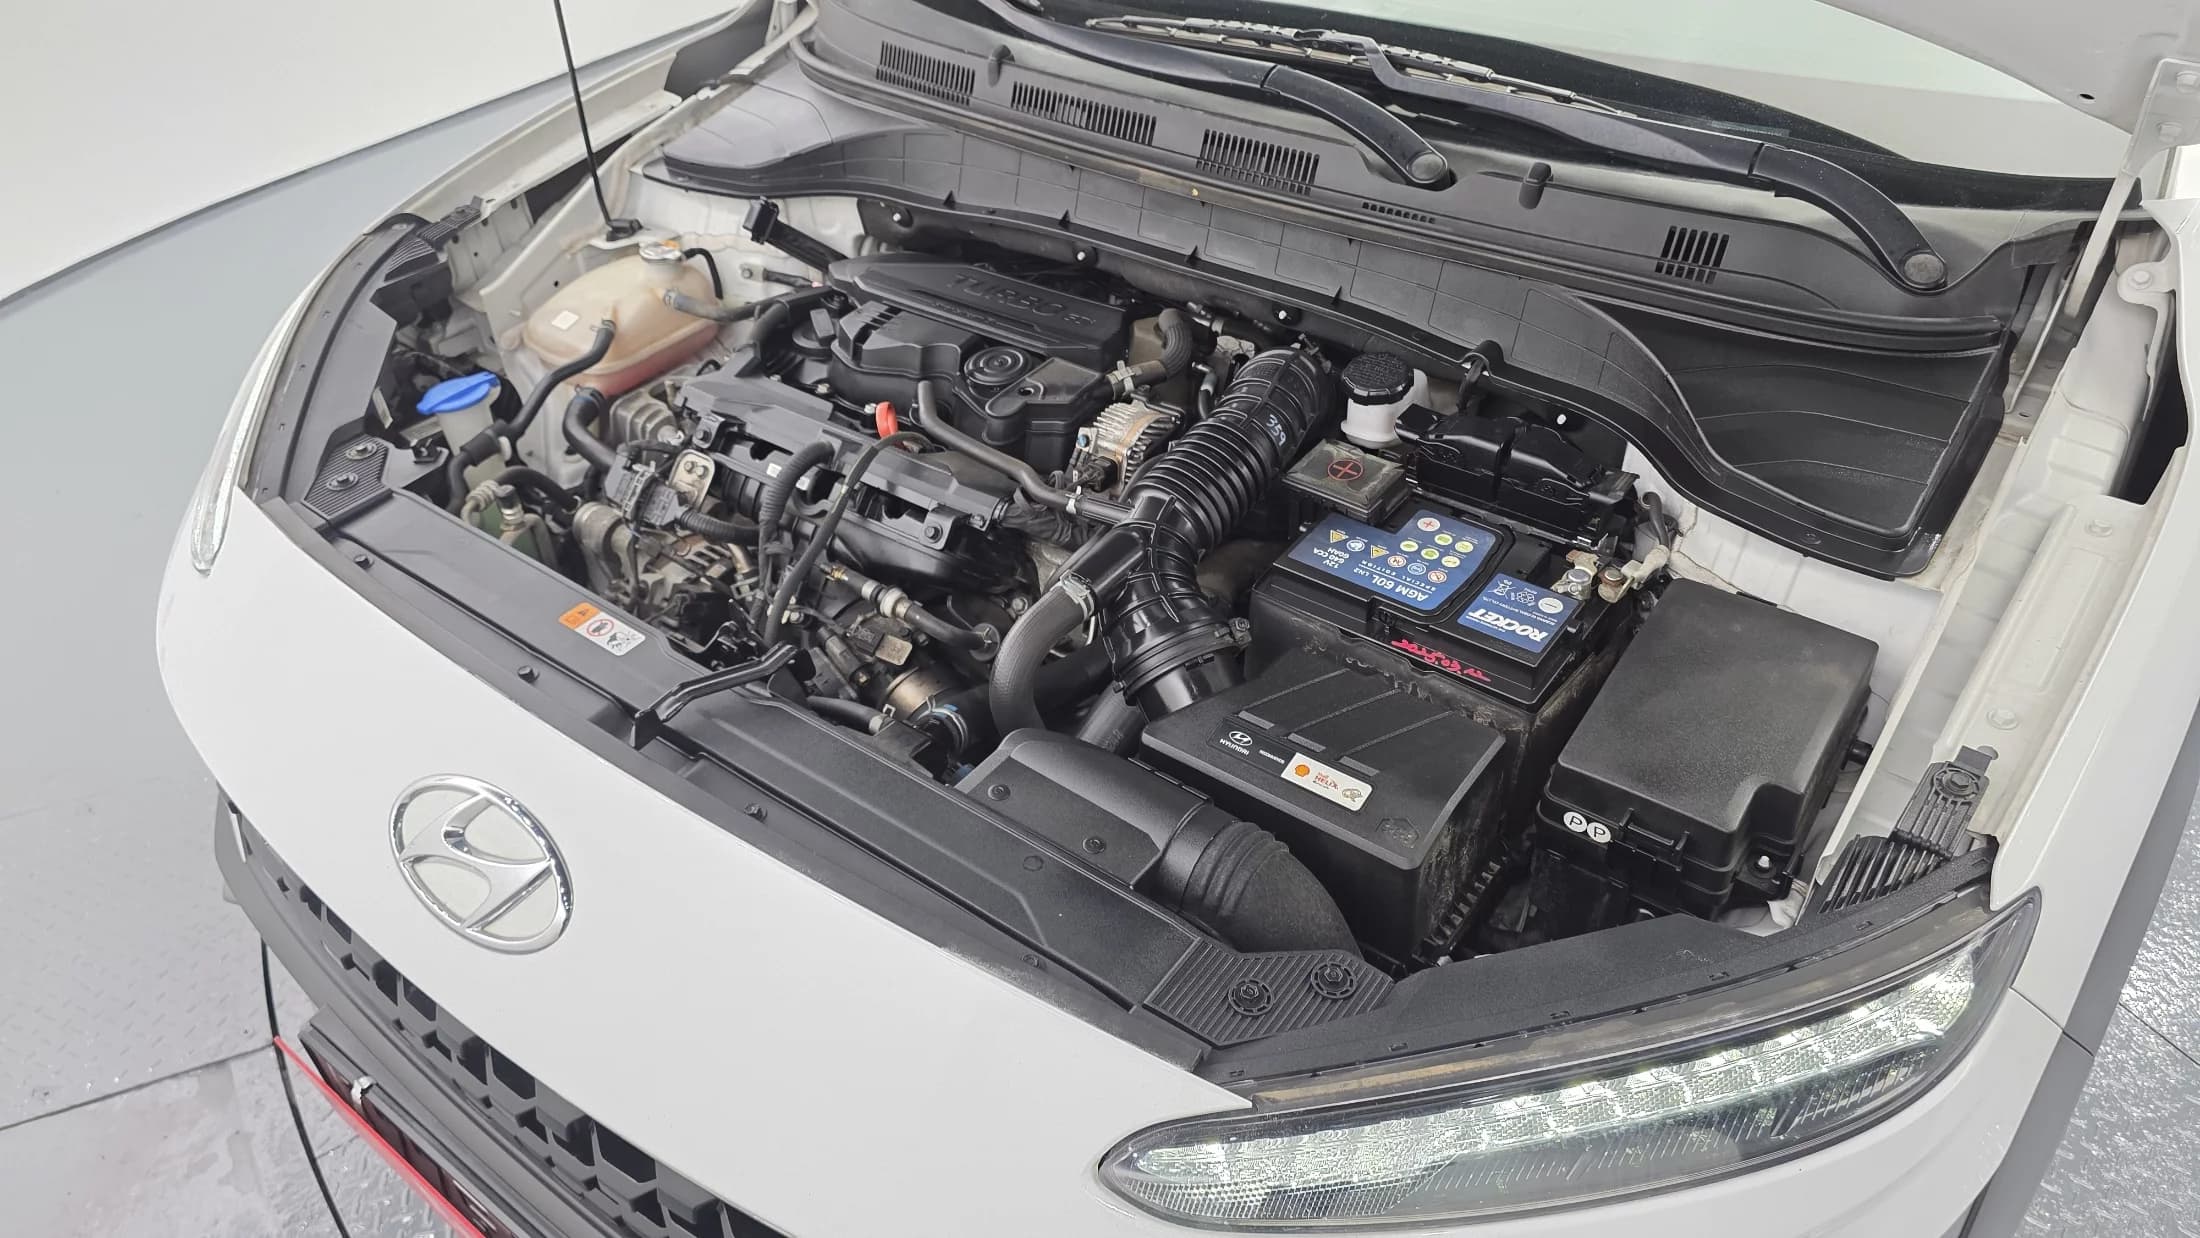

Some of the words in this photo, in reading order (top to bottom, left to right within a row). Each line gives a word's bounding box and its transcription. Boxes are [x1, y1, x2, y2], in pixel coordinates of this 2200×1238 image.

[948, 273, 1063, 316] TURBO
[1265, 414, 1287, 447] 359
[1313, 547, 1328, 558] CCA
[1323, 560, 1339, 569] 12V
[1361, 560, 1397, 576] EDITION
[1371, 574, 1396, 590] 60L
[1401, 575, 1436, 592] SPECIAL
[1395, 586, 1431, 602] AGM
[1467, 608, 1549, 642] ROCKET
[1219, 738, 1250, 756] HYUNDAI
[1315, 775, 1337, 790] HELIX
[1569, 815, 1583, 826] P
[1593, 826, 1606, 838] P
